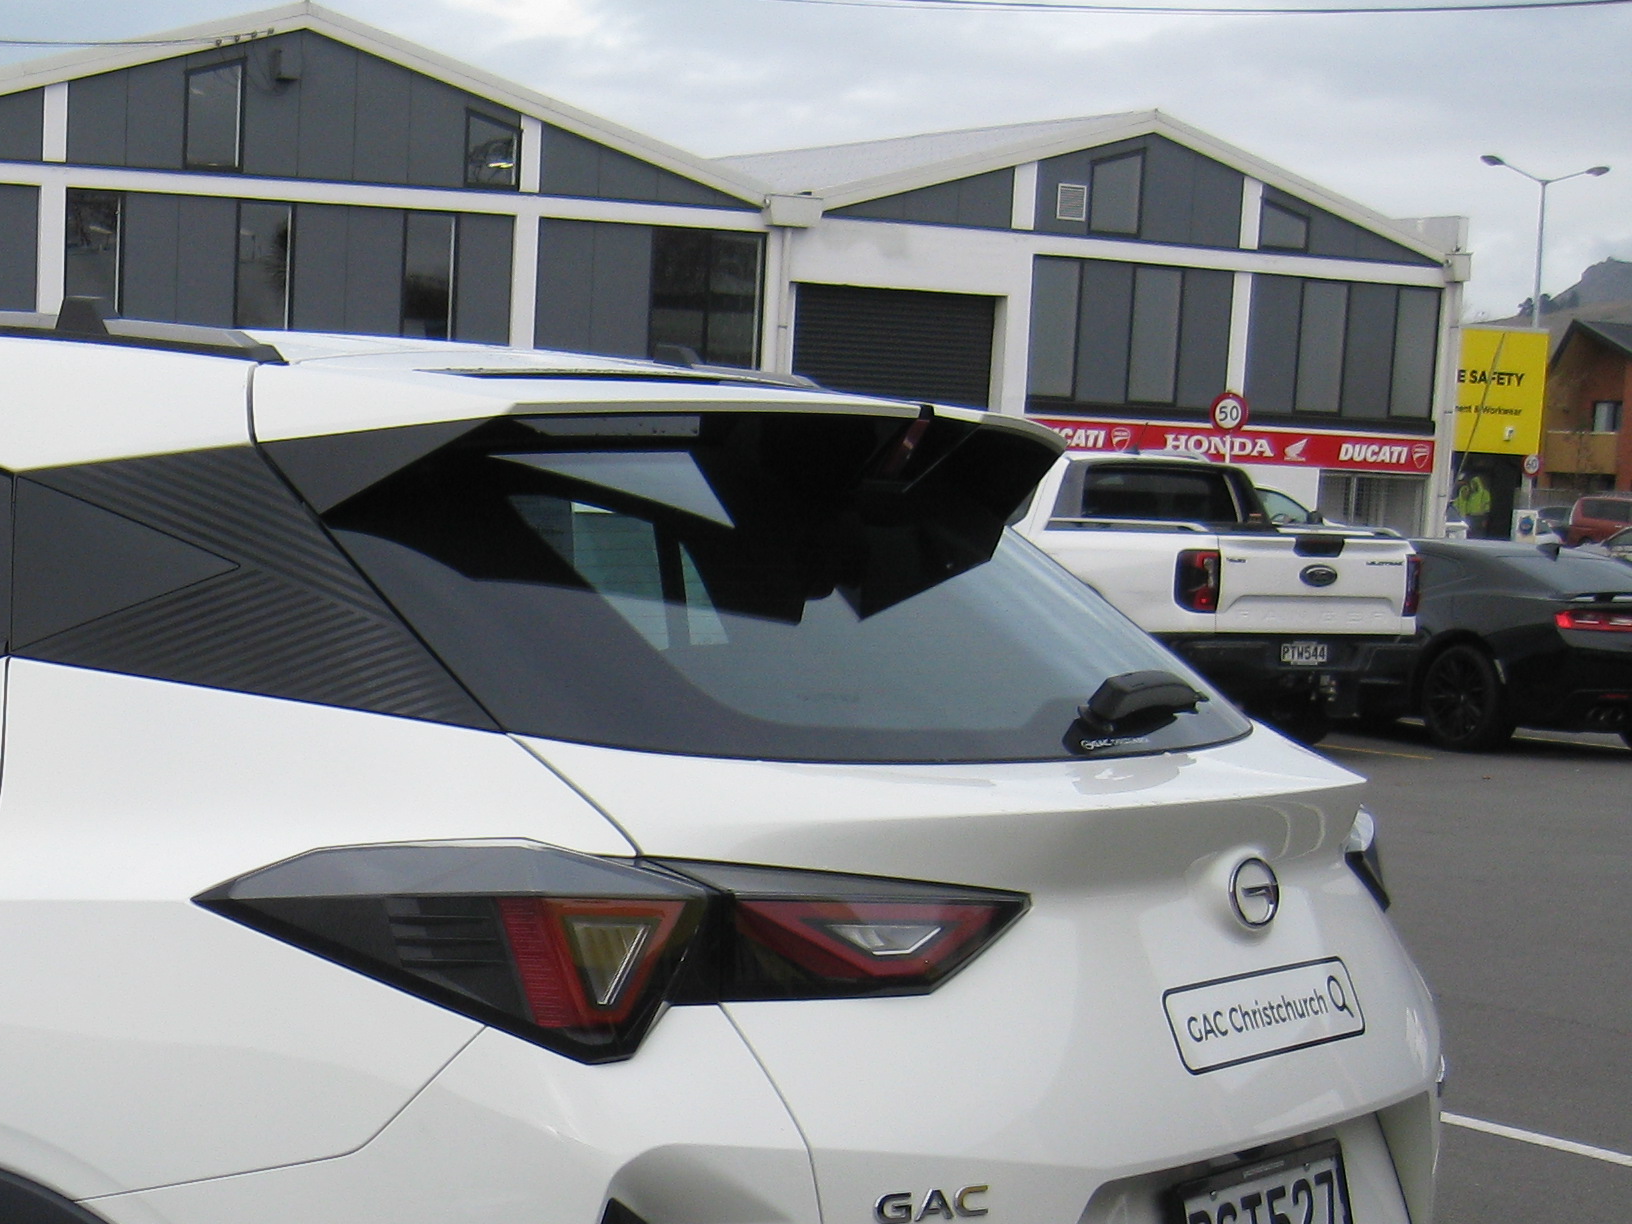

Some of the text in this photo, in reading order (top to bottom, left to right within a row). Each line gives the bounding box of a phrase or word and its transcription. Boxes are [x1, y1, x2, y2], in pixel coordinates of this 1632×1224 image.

[1469, 370, 1525, 386] SAFETY
[1218, 405, 1240, 422] 50
[1052, 426, 1107, 448] CATI
[1164, 433, 1274, 457] HONDA
[1338, 443, 1409, 464] DUCATI
[1186, 988, 1329, 1043] GAC Christchurch
[873, 1184, 988, 1224] GAC
